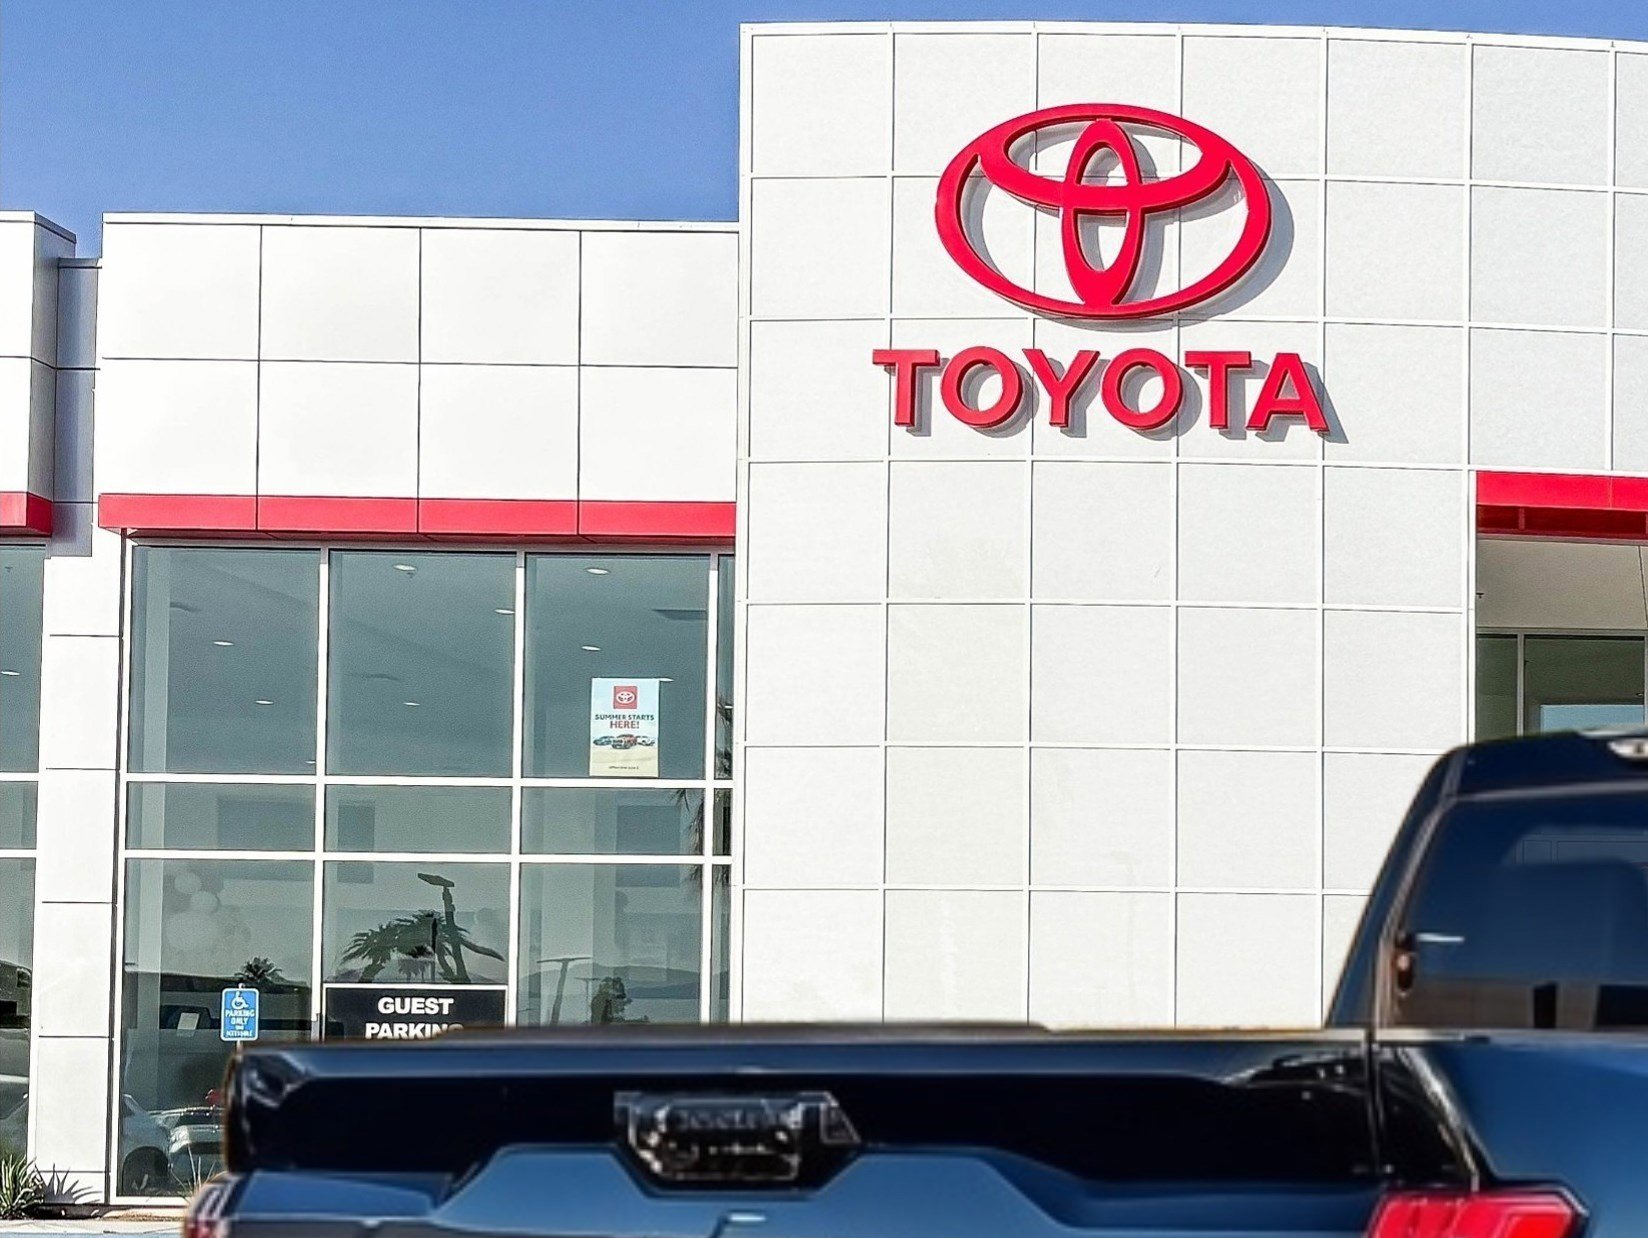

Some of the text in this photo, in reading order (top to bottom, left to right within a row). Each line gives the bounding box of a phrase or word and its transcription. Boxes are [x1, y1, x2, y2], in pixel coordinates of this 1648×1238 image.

[872, 346, 1330, 432] TOYOTA
[609, 720, 640, 729] HERE!
[377, 997, 454, 1015] GUEST
[365, 1022, 464, 1040] PARKIN
